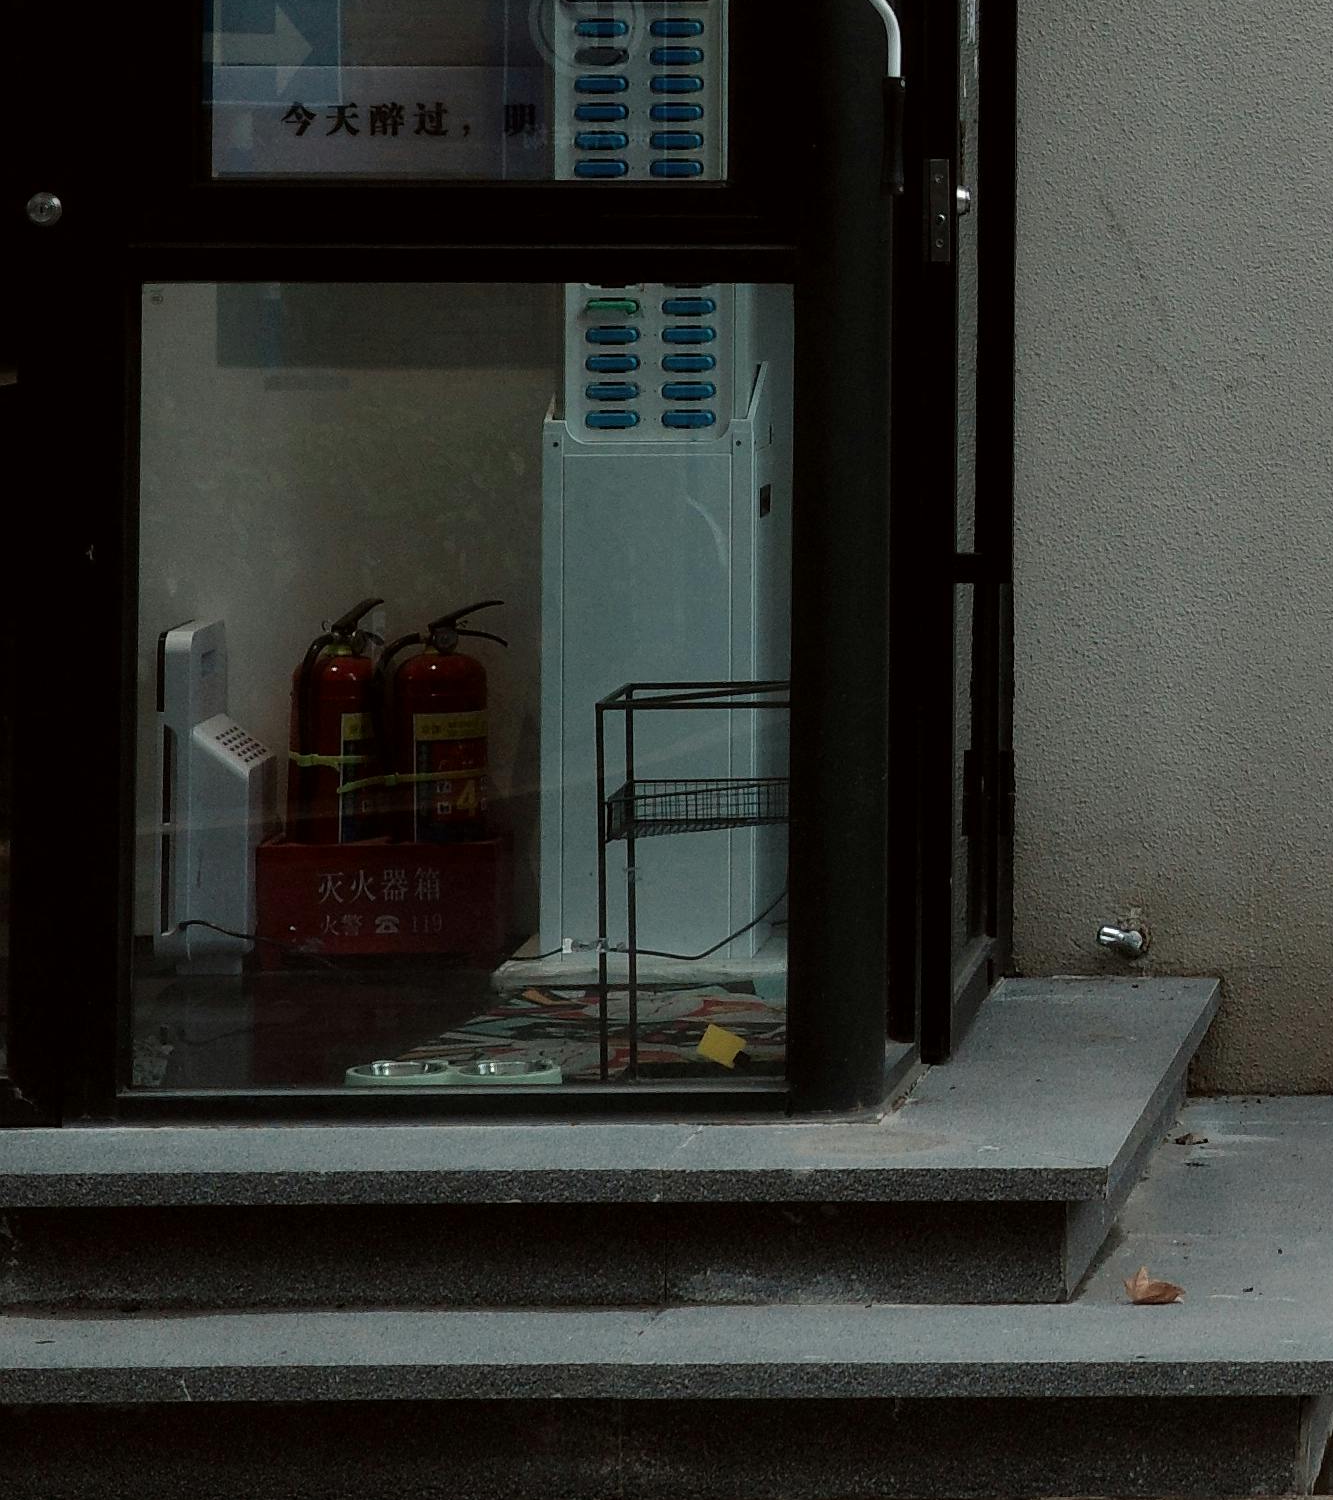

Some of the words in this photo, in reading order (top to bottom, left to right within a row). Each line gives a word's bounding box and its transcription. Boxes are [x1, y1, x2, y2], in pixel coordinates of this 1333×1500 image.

[317, 867, 441, 903] 灭火器箱
[320, 914, 363, 937] 火警
